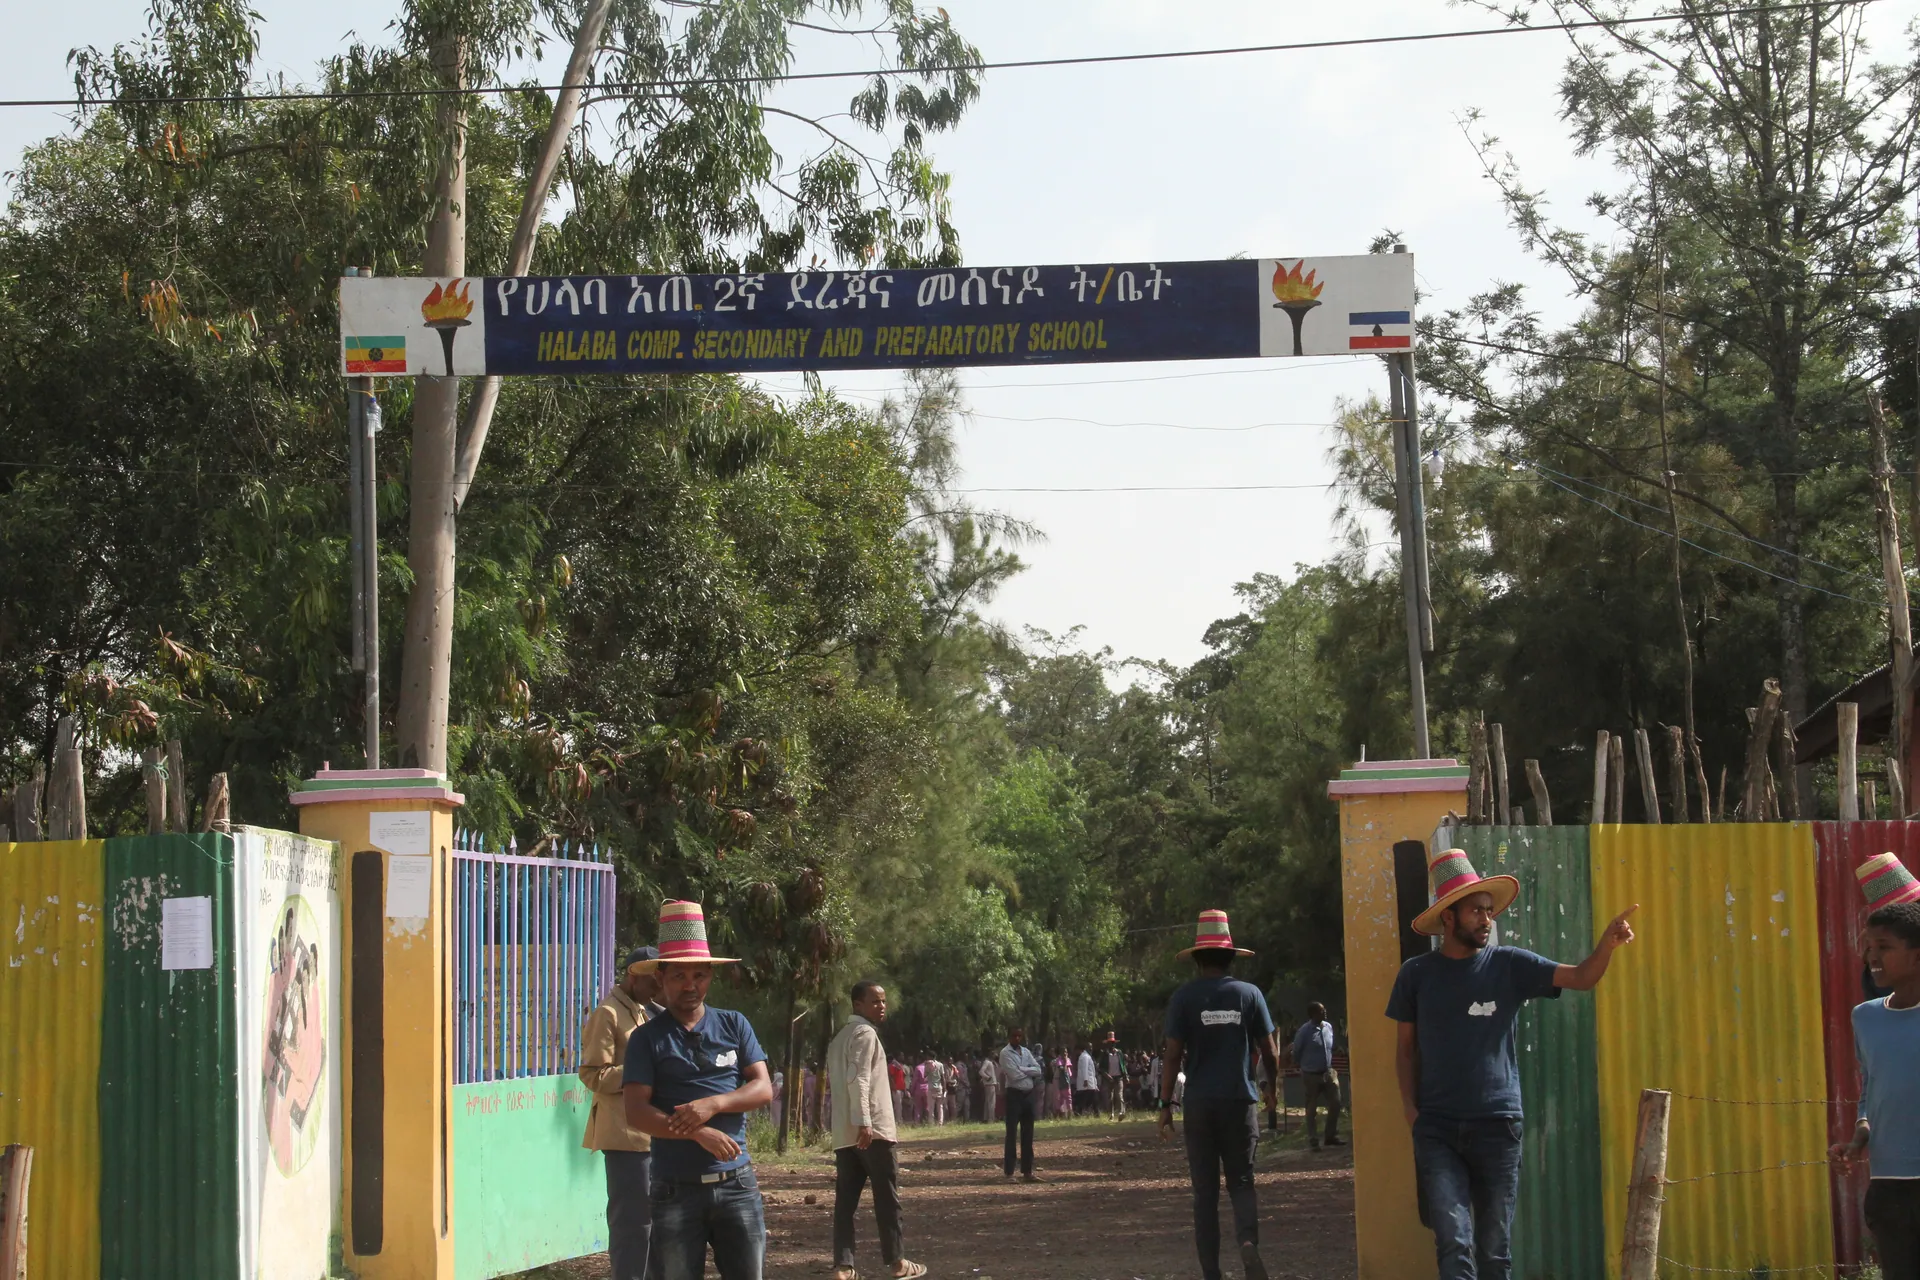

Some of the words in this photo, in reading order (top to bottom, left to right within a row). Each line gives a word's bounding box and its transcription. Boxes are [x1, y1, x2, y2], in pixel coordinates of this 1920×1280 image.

[497, 278, 607, 316] የሀላባ
[714, 273, 765, 311] 2ኛ
[785, 271, 894, 311] ደረጃና
[917, 266, 1044, 307] መሰናዶ
[1069, 264, 1172, 304] ት/ቤት
[537, 330, 616, 361] HALABA
[627, 329, 683, 360] COMP.
[692, 328, 812, 360] SECONDARY
[819, 327, 863, 358] AND
[874, 322, 1020, 357] PREPARATORY
[1028, 319, 1107, 352] SCHOOL
